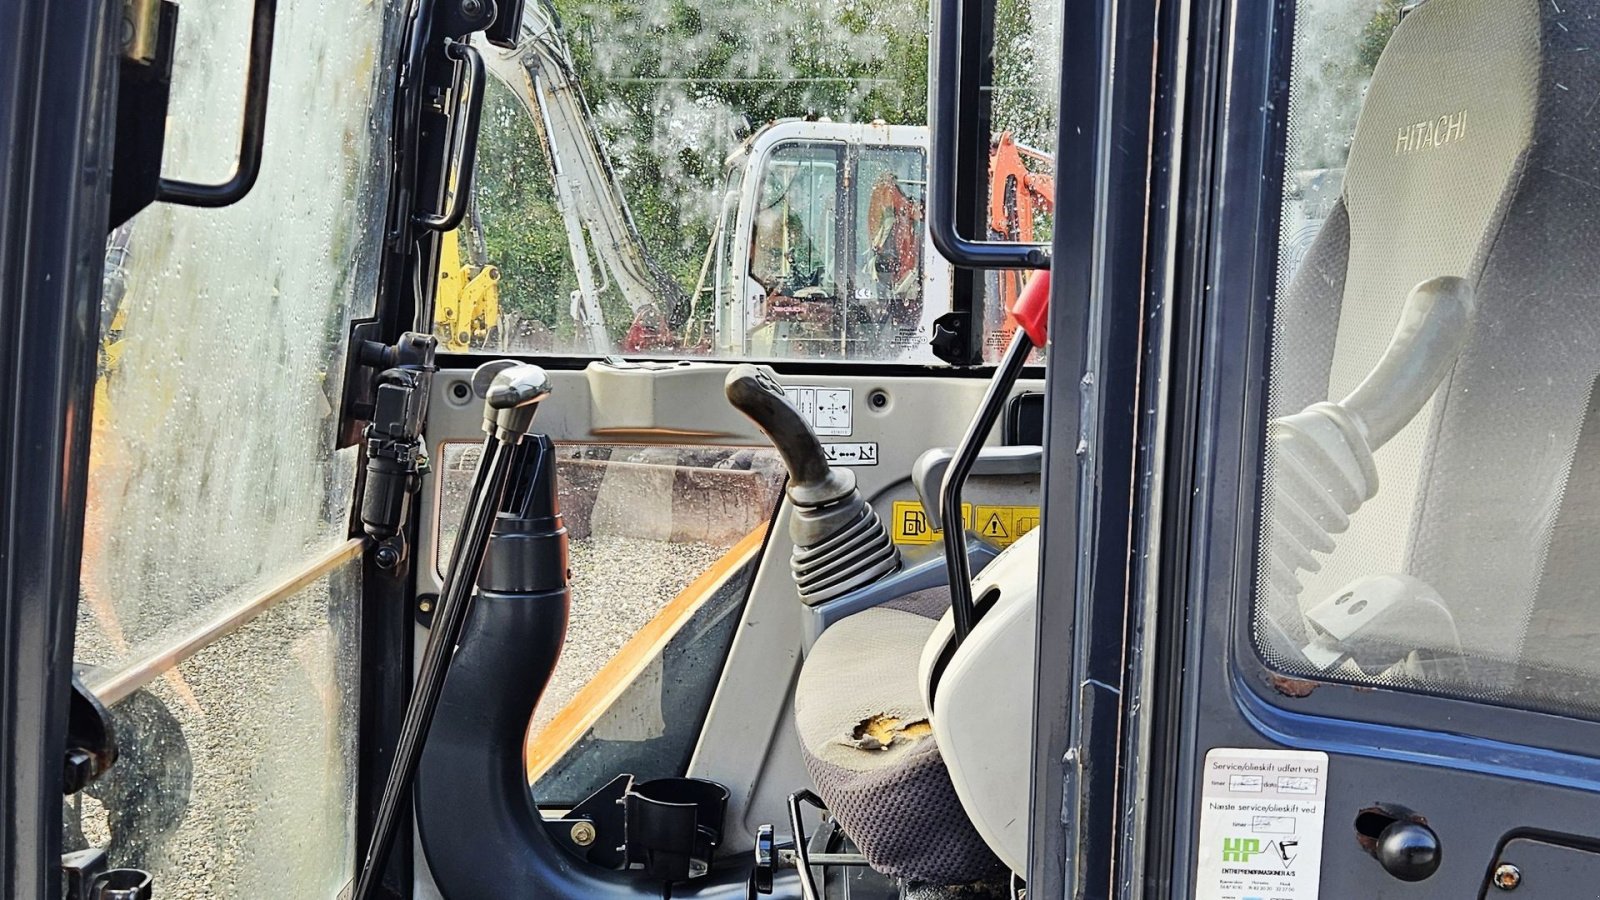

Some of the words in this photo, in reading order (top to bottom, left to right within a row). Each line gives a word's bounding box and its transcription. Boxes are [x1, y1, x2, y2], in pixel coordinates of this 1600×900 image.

[1392, 109, 1449, 154] HITACHI
[1212, 762, 1275, 772] Service/olieskift
[1277, 763, 1301, 773] udført
[1304, 765, 1319, 774] ved
[1209, 802, 1235, 811] Næste
[1238, 803, 1299, 814] service/olieskift
[1301, 805, 1316, 814] ved
[1222, 838, 1260, 862] HP
